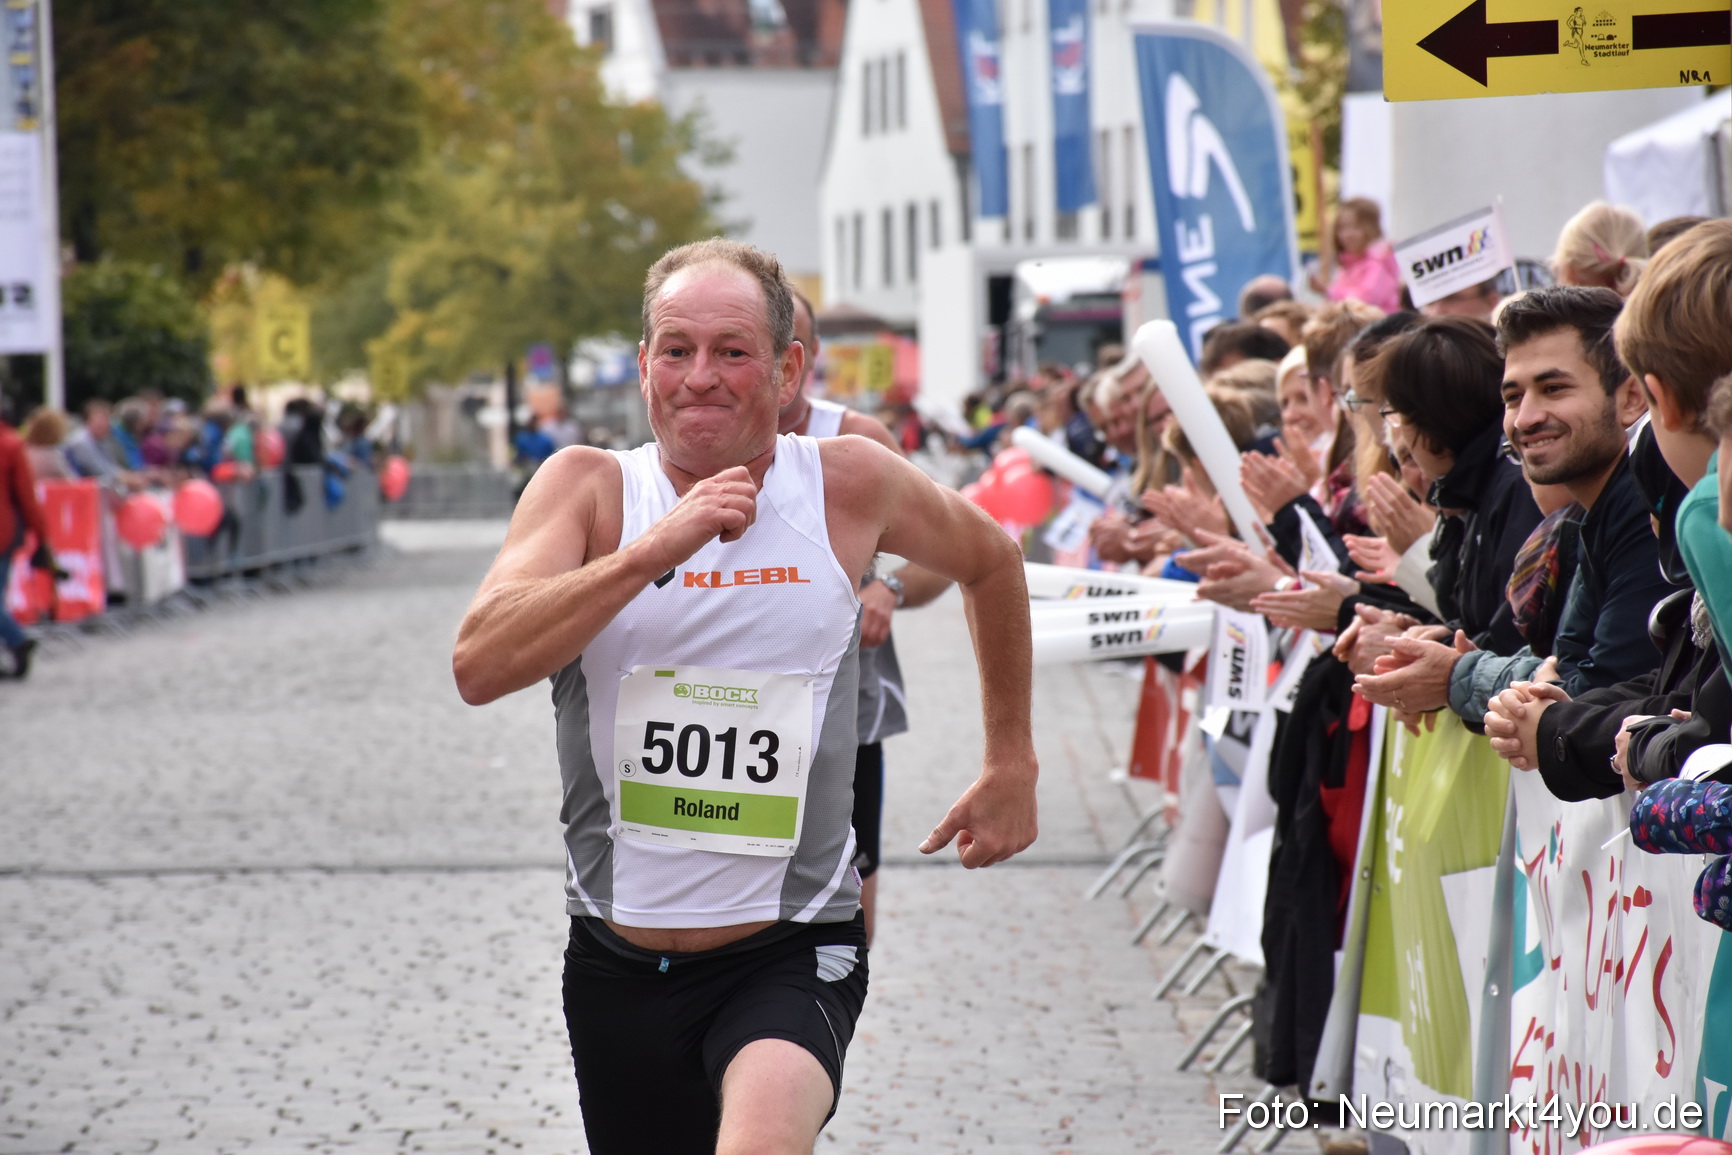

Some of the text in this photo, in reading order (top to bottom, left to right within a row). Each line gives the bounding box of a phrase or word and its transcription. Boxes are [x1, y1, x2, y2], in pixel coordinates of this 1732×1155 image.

[1585, 43, 1630, 51] Neumarkter
[1593, 50, 1630, 58] Stadtlauf
[1411, 245, 1464, 279] swn
[684, 567, 811, 588] KLEBL
[1088, 610, 1141, 625] swn
[1090, 629, 1143, 648] swn
[1228, 647, 1246, 699] swn
[693, 684, 759, 704] BOCK
[641, 721, 780, 783] 5013
[673, 797, 740, 821] Roland
